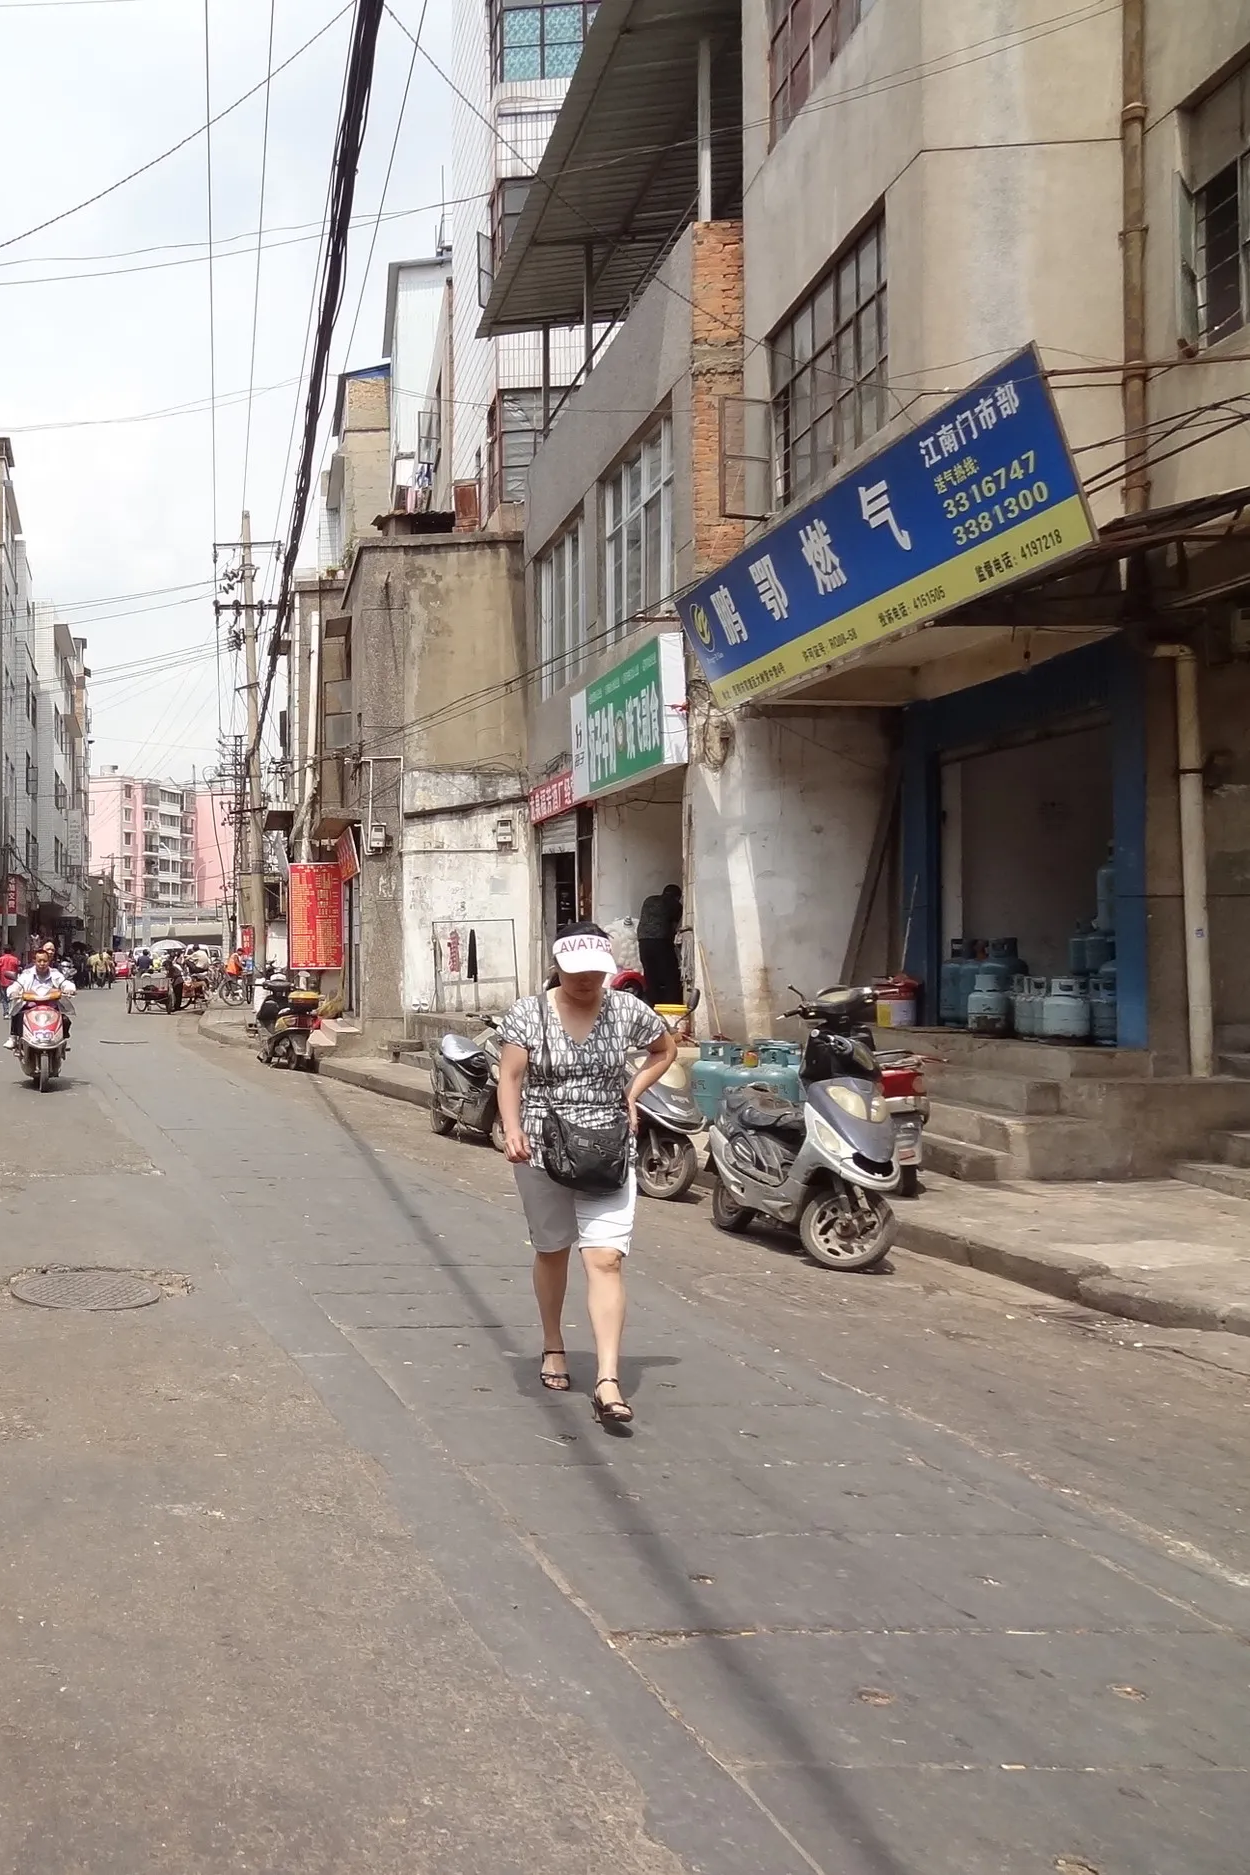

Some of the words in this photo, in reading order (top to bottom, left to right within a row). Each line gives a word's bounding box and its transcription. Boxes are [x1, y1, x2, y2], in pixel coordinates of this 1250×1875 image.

[919, 380, 1020, 468] 江南门市部
[943, 450, 1035, 518] 3316747
[953, 482, 1048, 545] 3381300
[1020, 528, 1062, 561] 4197218
[913, 585, 946, 611] 4151505
